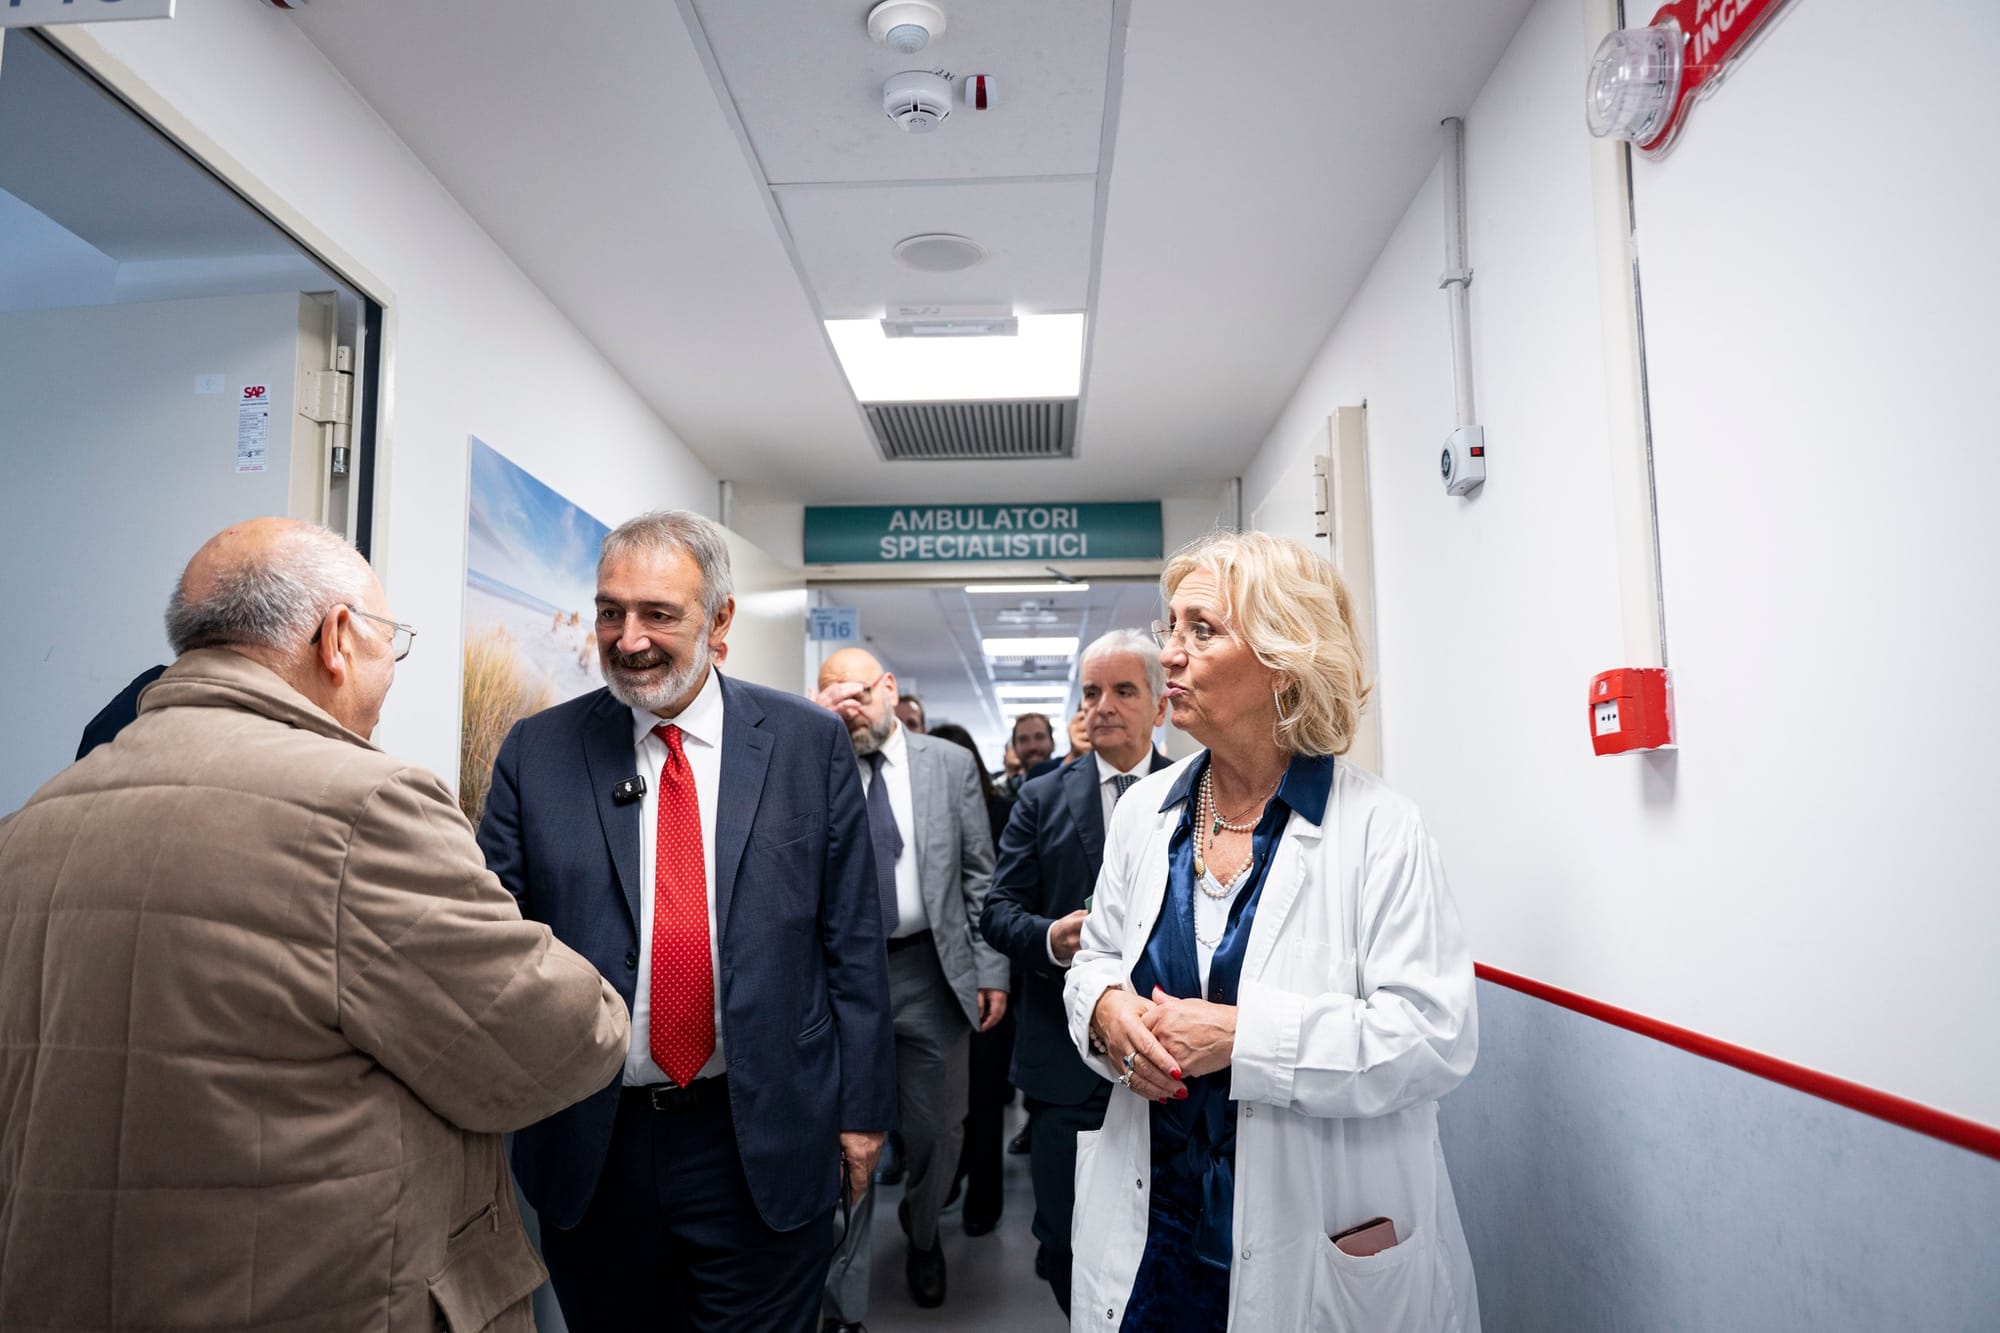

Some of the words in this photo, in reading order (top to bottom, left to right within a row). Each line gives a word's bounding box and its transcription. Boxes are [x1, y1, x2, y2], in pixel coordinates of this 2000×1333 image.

[244, 385, 266, 398] SAP
[888, 507, 1079, 532] AMBULATORI
[879, 533, 1088, 559] SPECIALISTICI
[817, 621, 851, 639] T16
